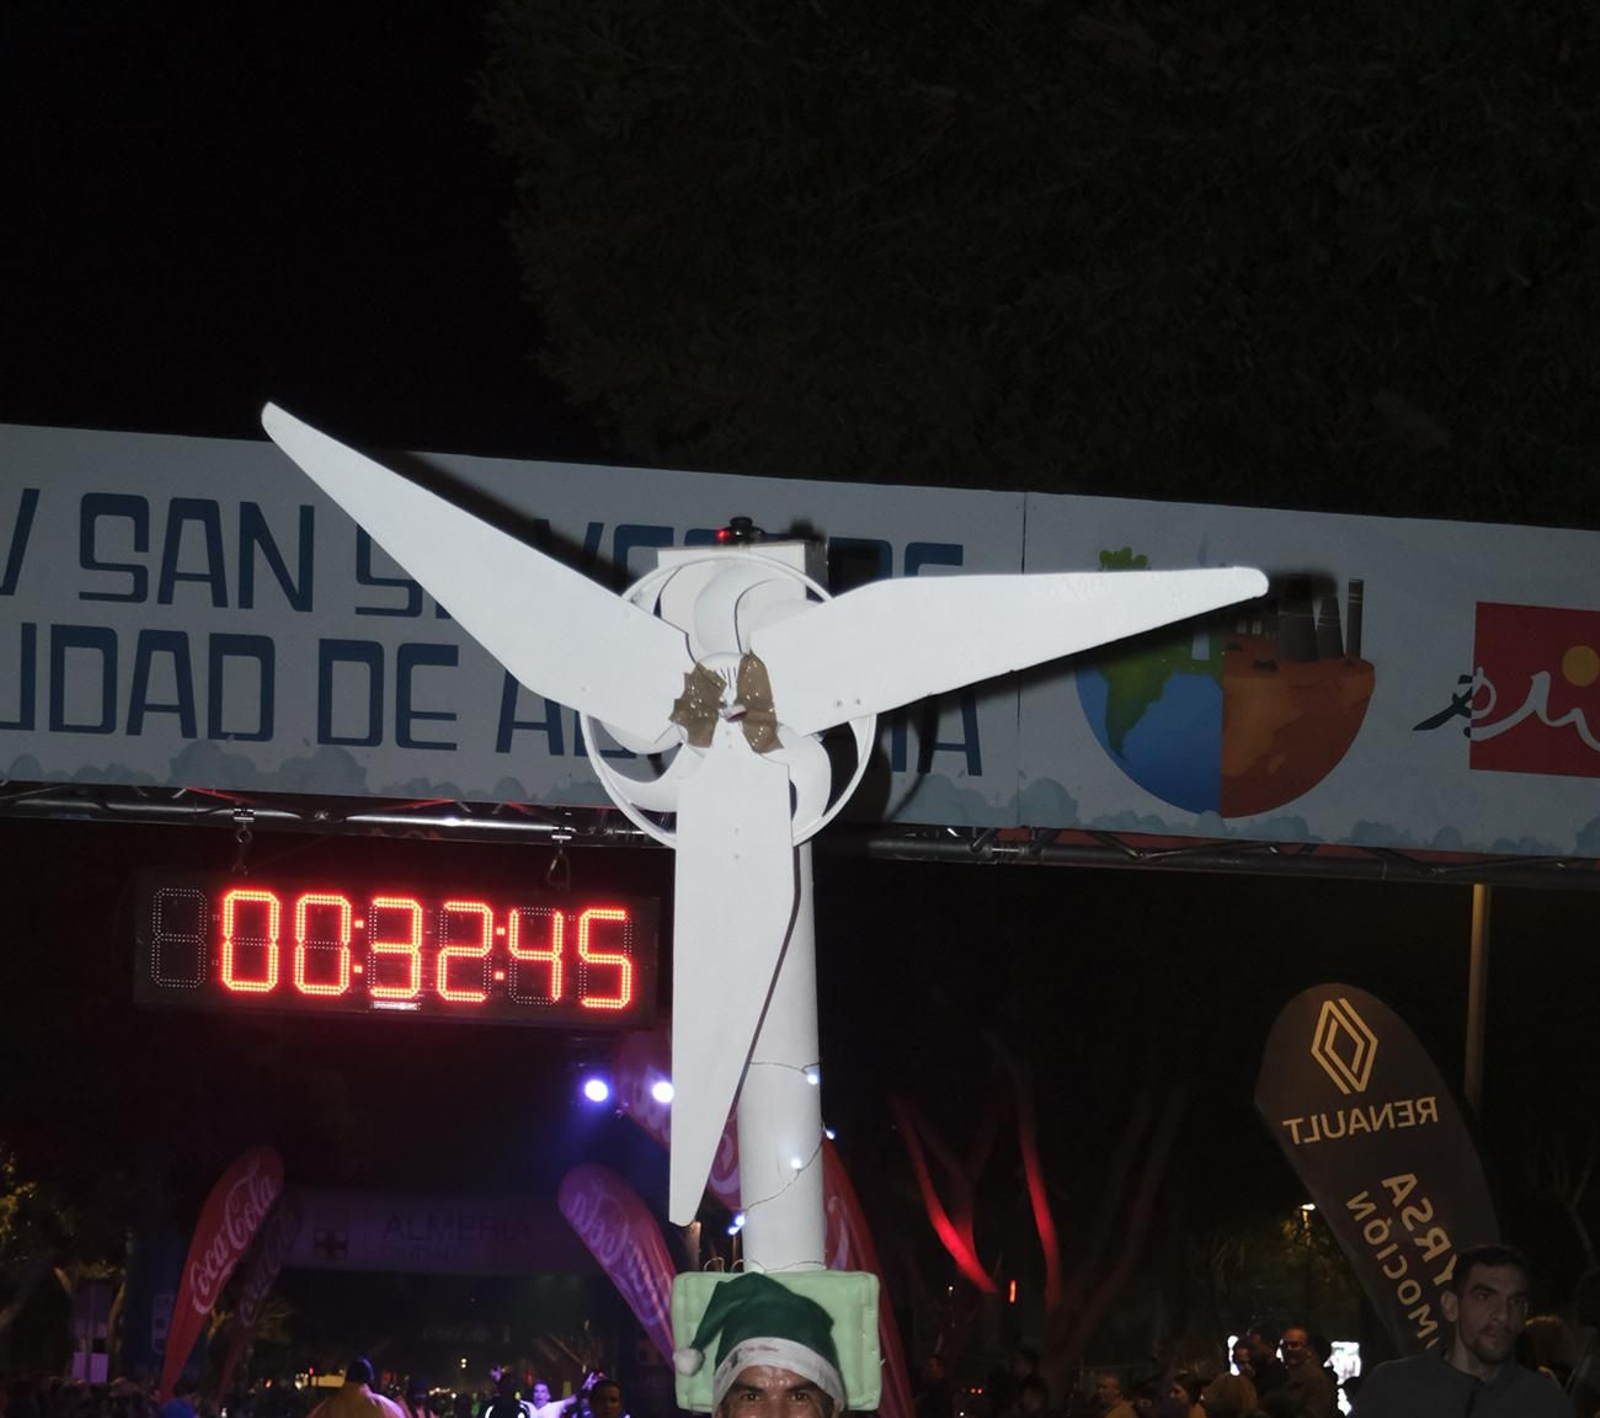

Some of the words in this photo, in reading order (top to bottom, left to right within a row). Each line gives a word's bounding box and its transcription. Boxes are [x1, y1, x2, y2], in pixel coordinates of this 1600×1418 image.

[79, 492, 314, 613] SAN
[317, 637, 459, 752] DE
[221, 888, 634, 1009] 00:32:45
